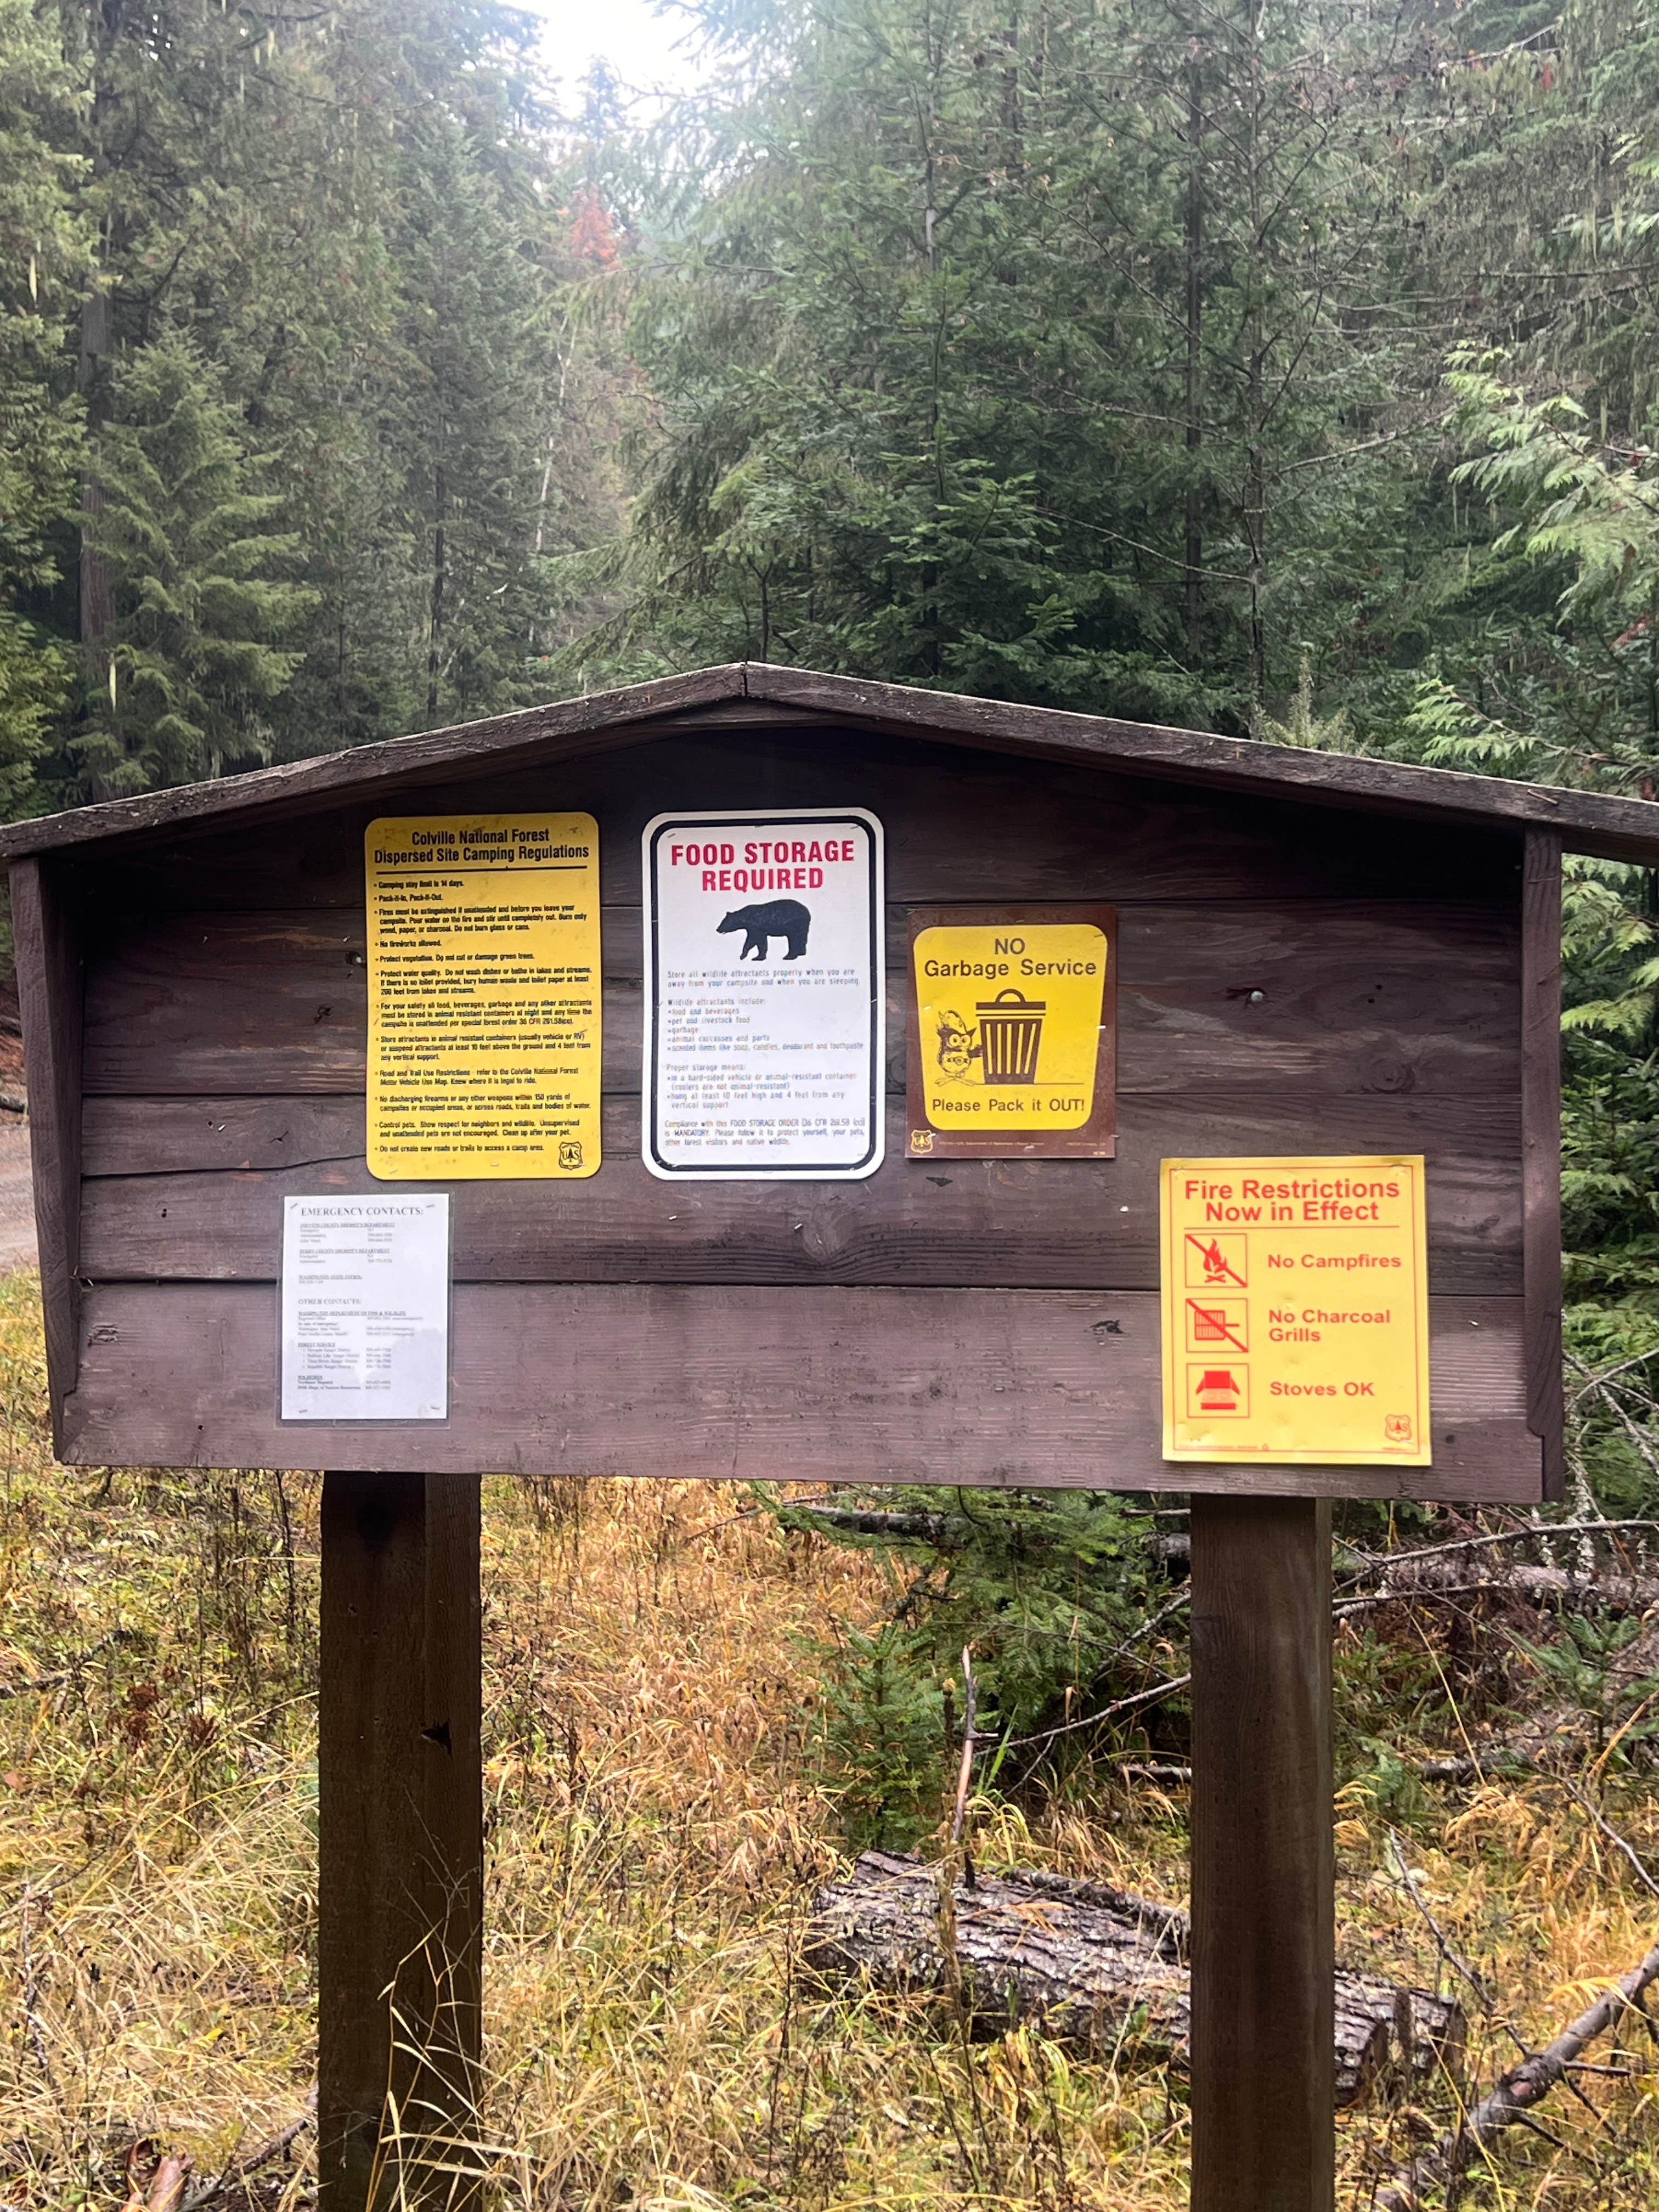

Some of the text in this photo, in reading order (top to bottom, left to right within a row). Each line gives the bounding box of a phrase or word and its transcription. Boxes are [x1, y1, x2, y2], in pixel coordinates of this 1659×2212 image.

[412, 828, 549, 844] Colville National Forest
[375, 844, 589, 865] Dispersed Site Camping Regulations
[672, 841, 854, 865] FOOD STORAGE
[702, 869, 823, 891] REQUIRED
[995, 938, 1025, 954] NO
[924, 958, 1096, 979] Garbage Service
[933, 1098, 1084, 1111] Please Pack it OUT!
[1186, 1178, 1400, 1199] Fire Restrictions
[1206, 1201, 1379, 1221] Now in Effect
[1268, 1254, 1402, 1270] No Campfires
[1269, 1310, 1390, 1323] No Charcoal
[1268, 1328, 1321, 1341] Grills
[1270, 1381, 1375, 1396] Stoves OK
